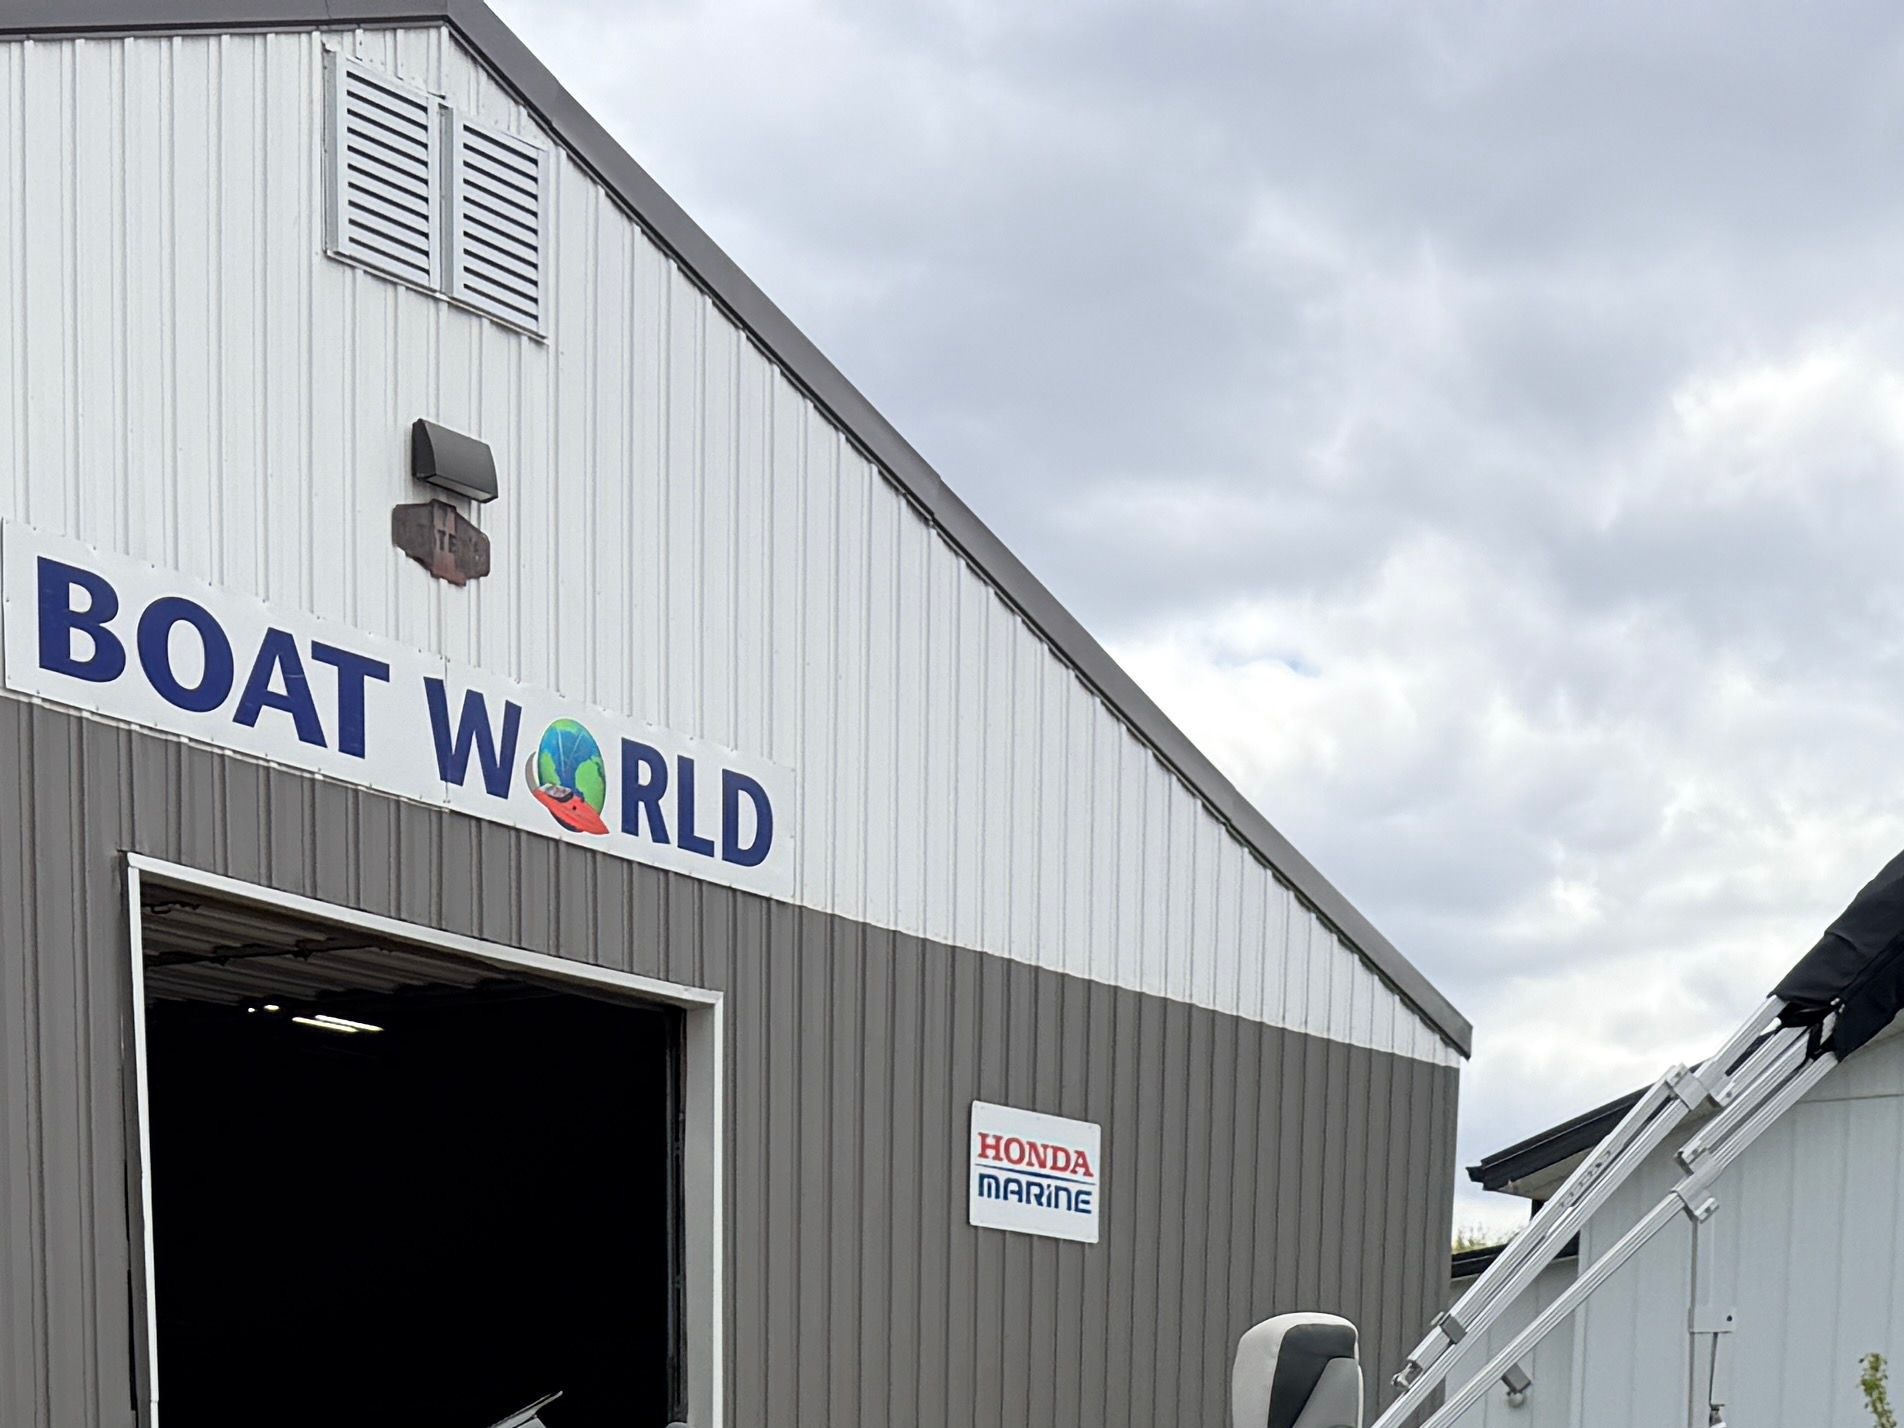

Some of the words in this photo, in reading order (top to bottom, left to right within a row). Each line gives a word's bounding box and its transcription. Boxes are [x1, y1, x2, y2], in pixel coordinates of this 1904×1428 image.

[37, 556, 390, 760] BOAT
[977, 1131, 1094, 1178] HONDA
[977, 1172, 1093, 1215] MARINE
